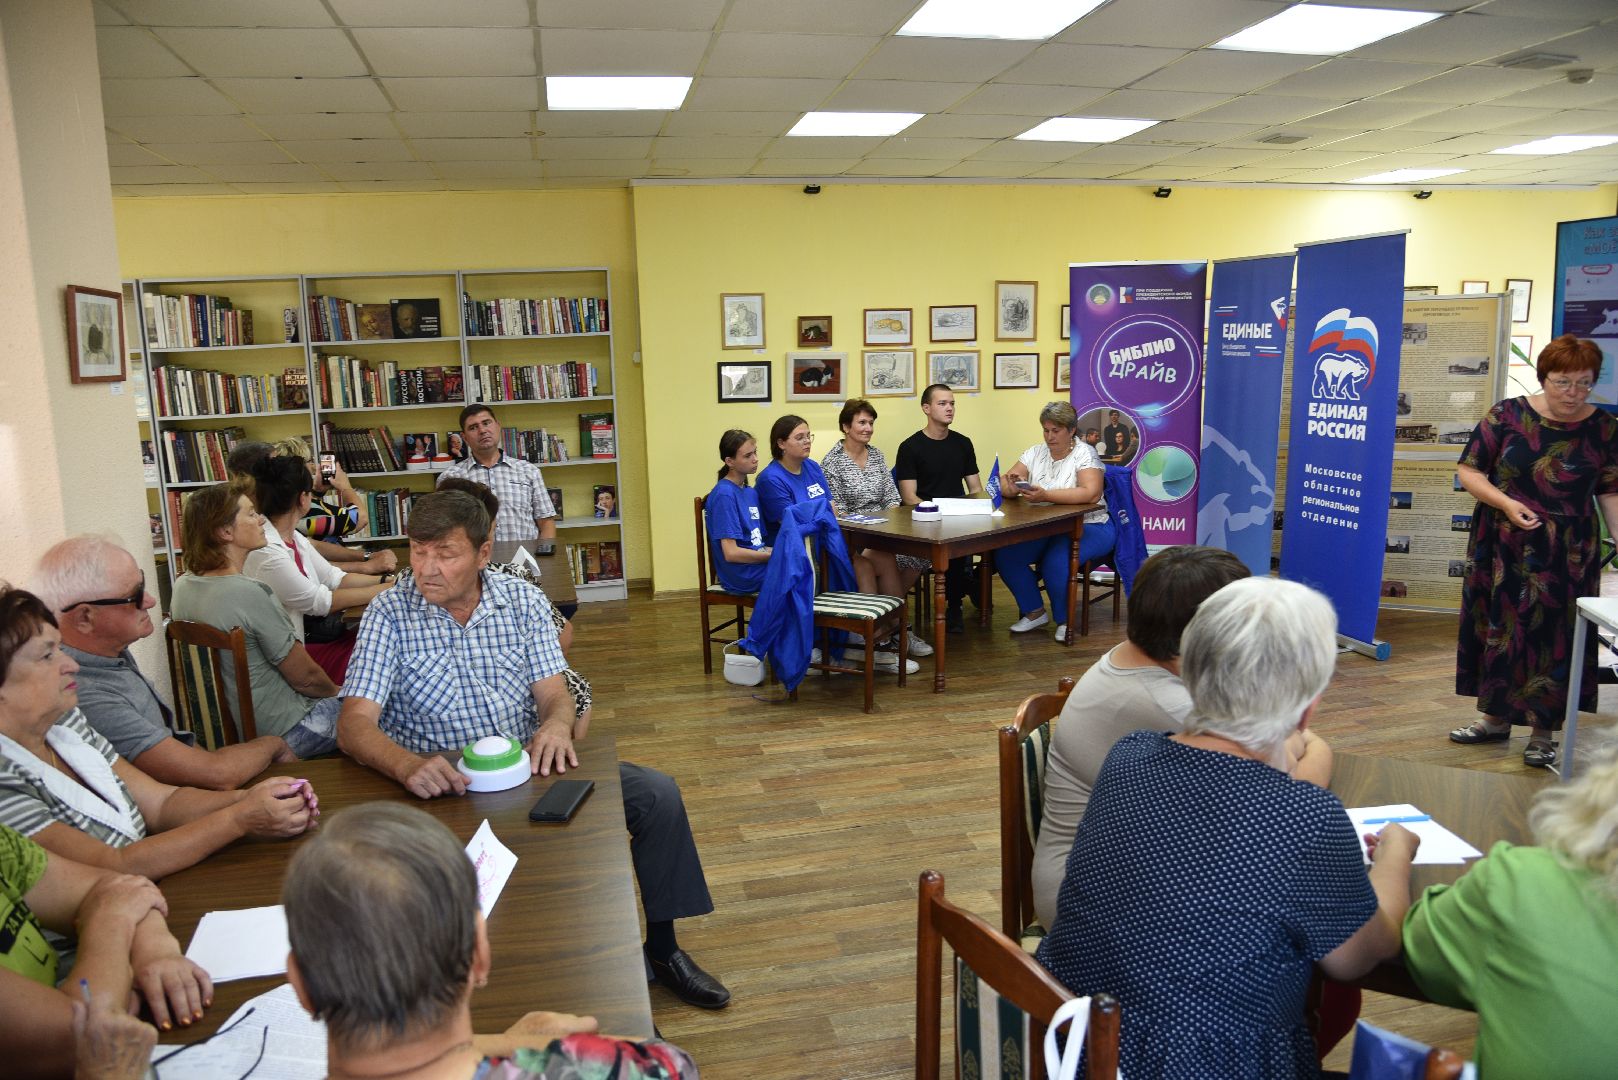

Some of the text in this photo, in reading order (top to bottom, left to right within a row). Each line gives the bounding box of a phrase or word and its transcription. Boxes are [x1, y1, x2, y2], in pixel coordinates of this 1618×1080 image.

[1222, 323, 1273, 340] ЕДИНЫЕ
[1108, 337, 1176, 365] БИБЛИО
[1108, 361, 1177, 383] ДРАЙВ
[416, 369, 425, 403] КОСТЮМ
[1308, 402, 1368, 421] ЕДИНАЯ
[1307, 420, 1367, 441] РОССИЯ
[1304, 463, 1362, 482] Московское
[1303, 479, 1361, 498] областное
[1302, 495, 1360, 514] региональное
[1142, 516, 1186, 532] НАМИ
[1301, 510, 1359, 530] отделение
